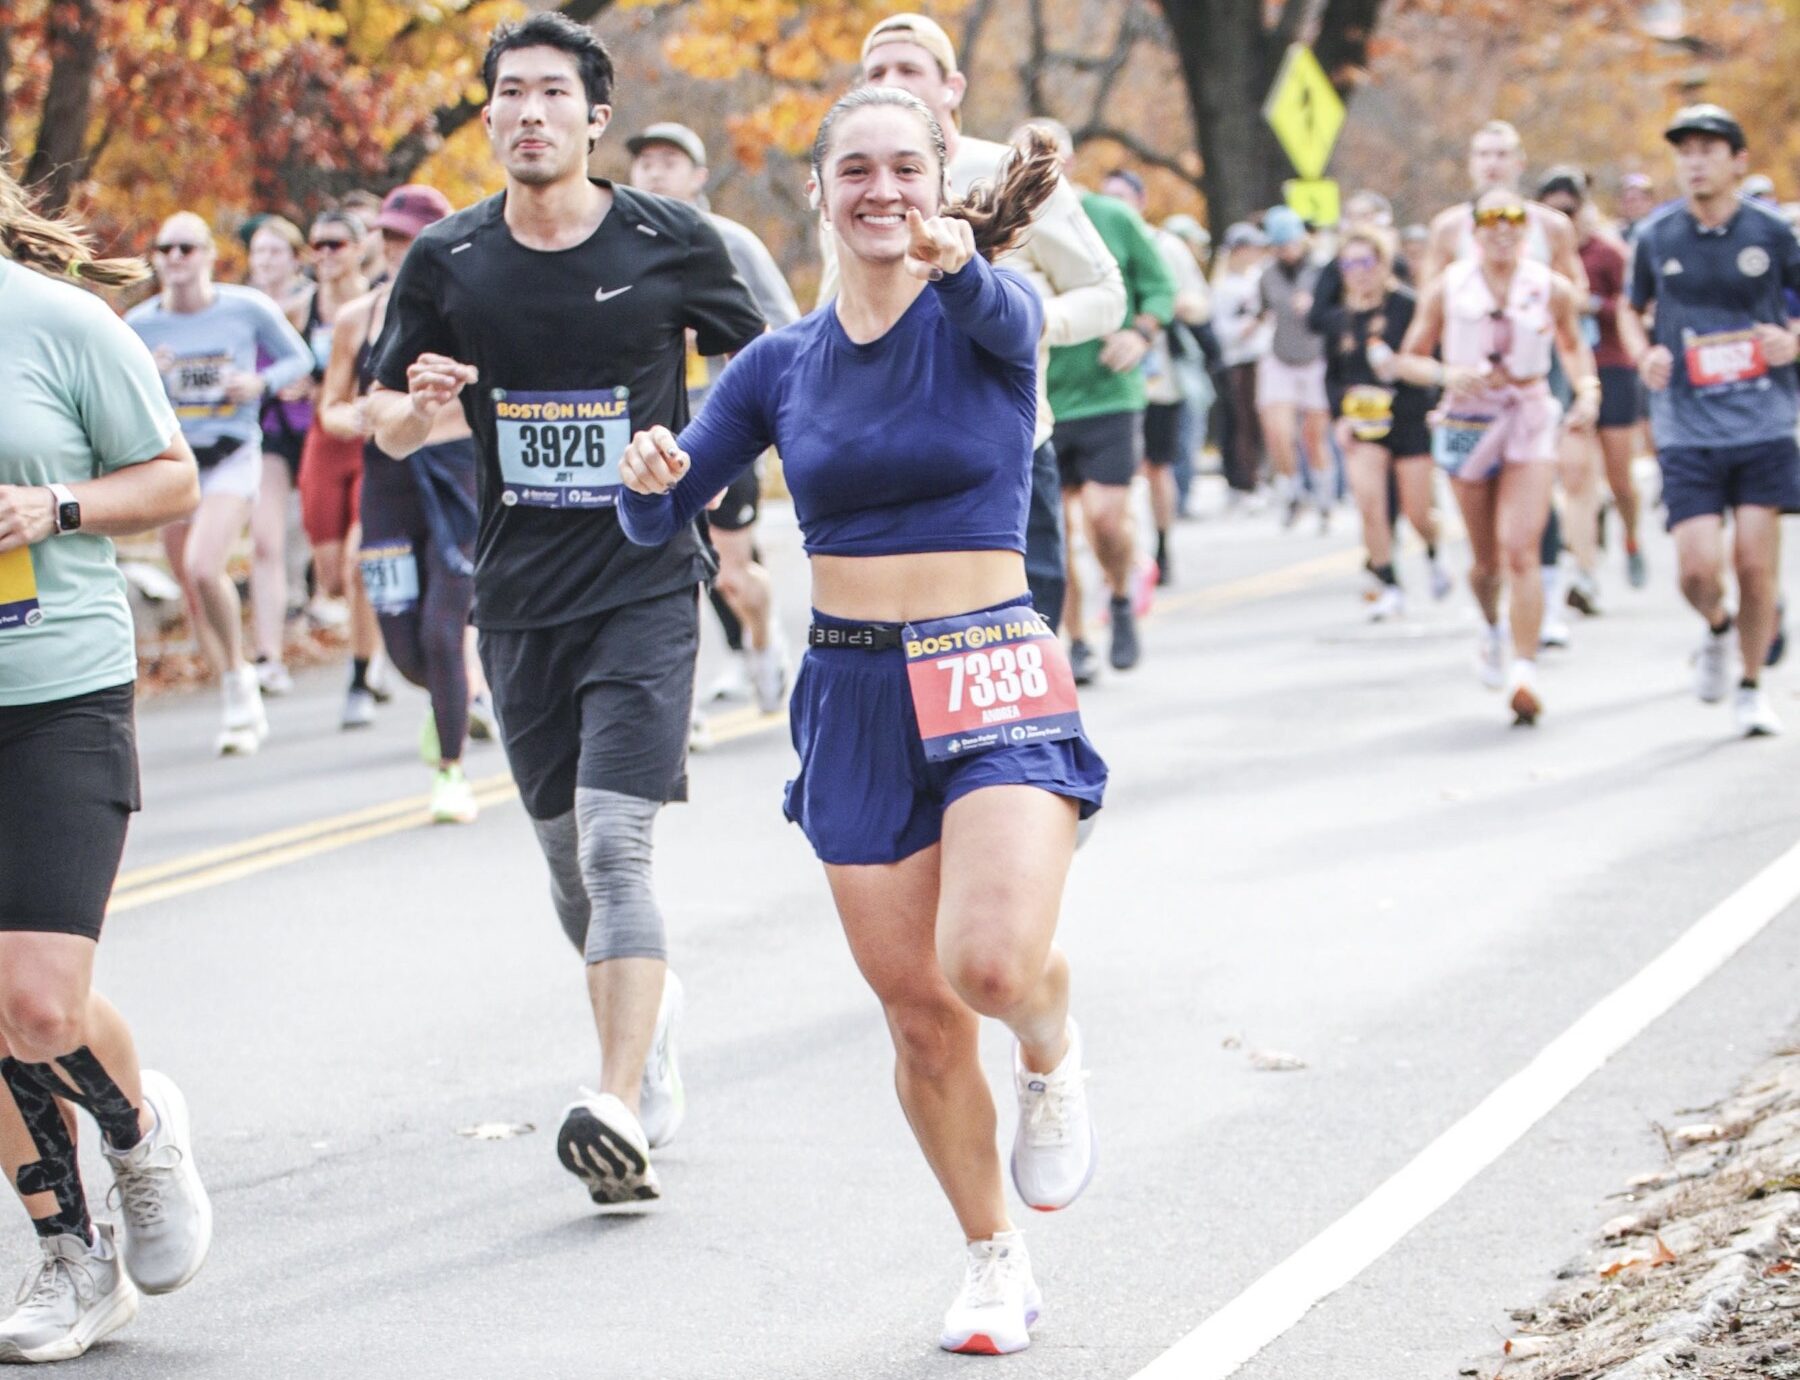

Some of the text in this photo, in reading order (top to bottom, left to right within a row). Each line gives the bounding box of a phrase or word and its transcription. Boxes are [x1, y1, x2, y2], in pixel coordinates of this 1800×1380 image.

[497, 401, 626, 420] BOSTON HALF
[519, 424, 605, 468] 3926
[906, 626, 1002, 658] BOSTON
[937, 644, 1048, 712] 7338
[982, 705, 1020, 723] ANDREA
